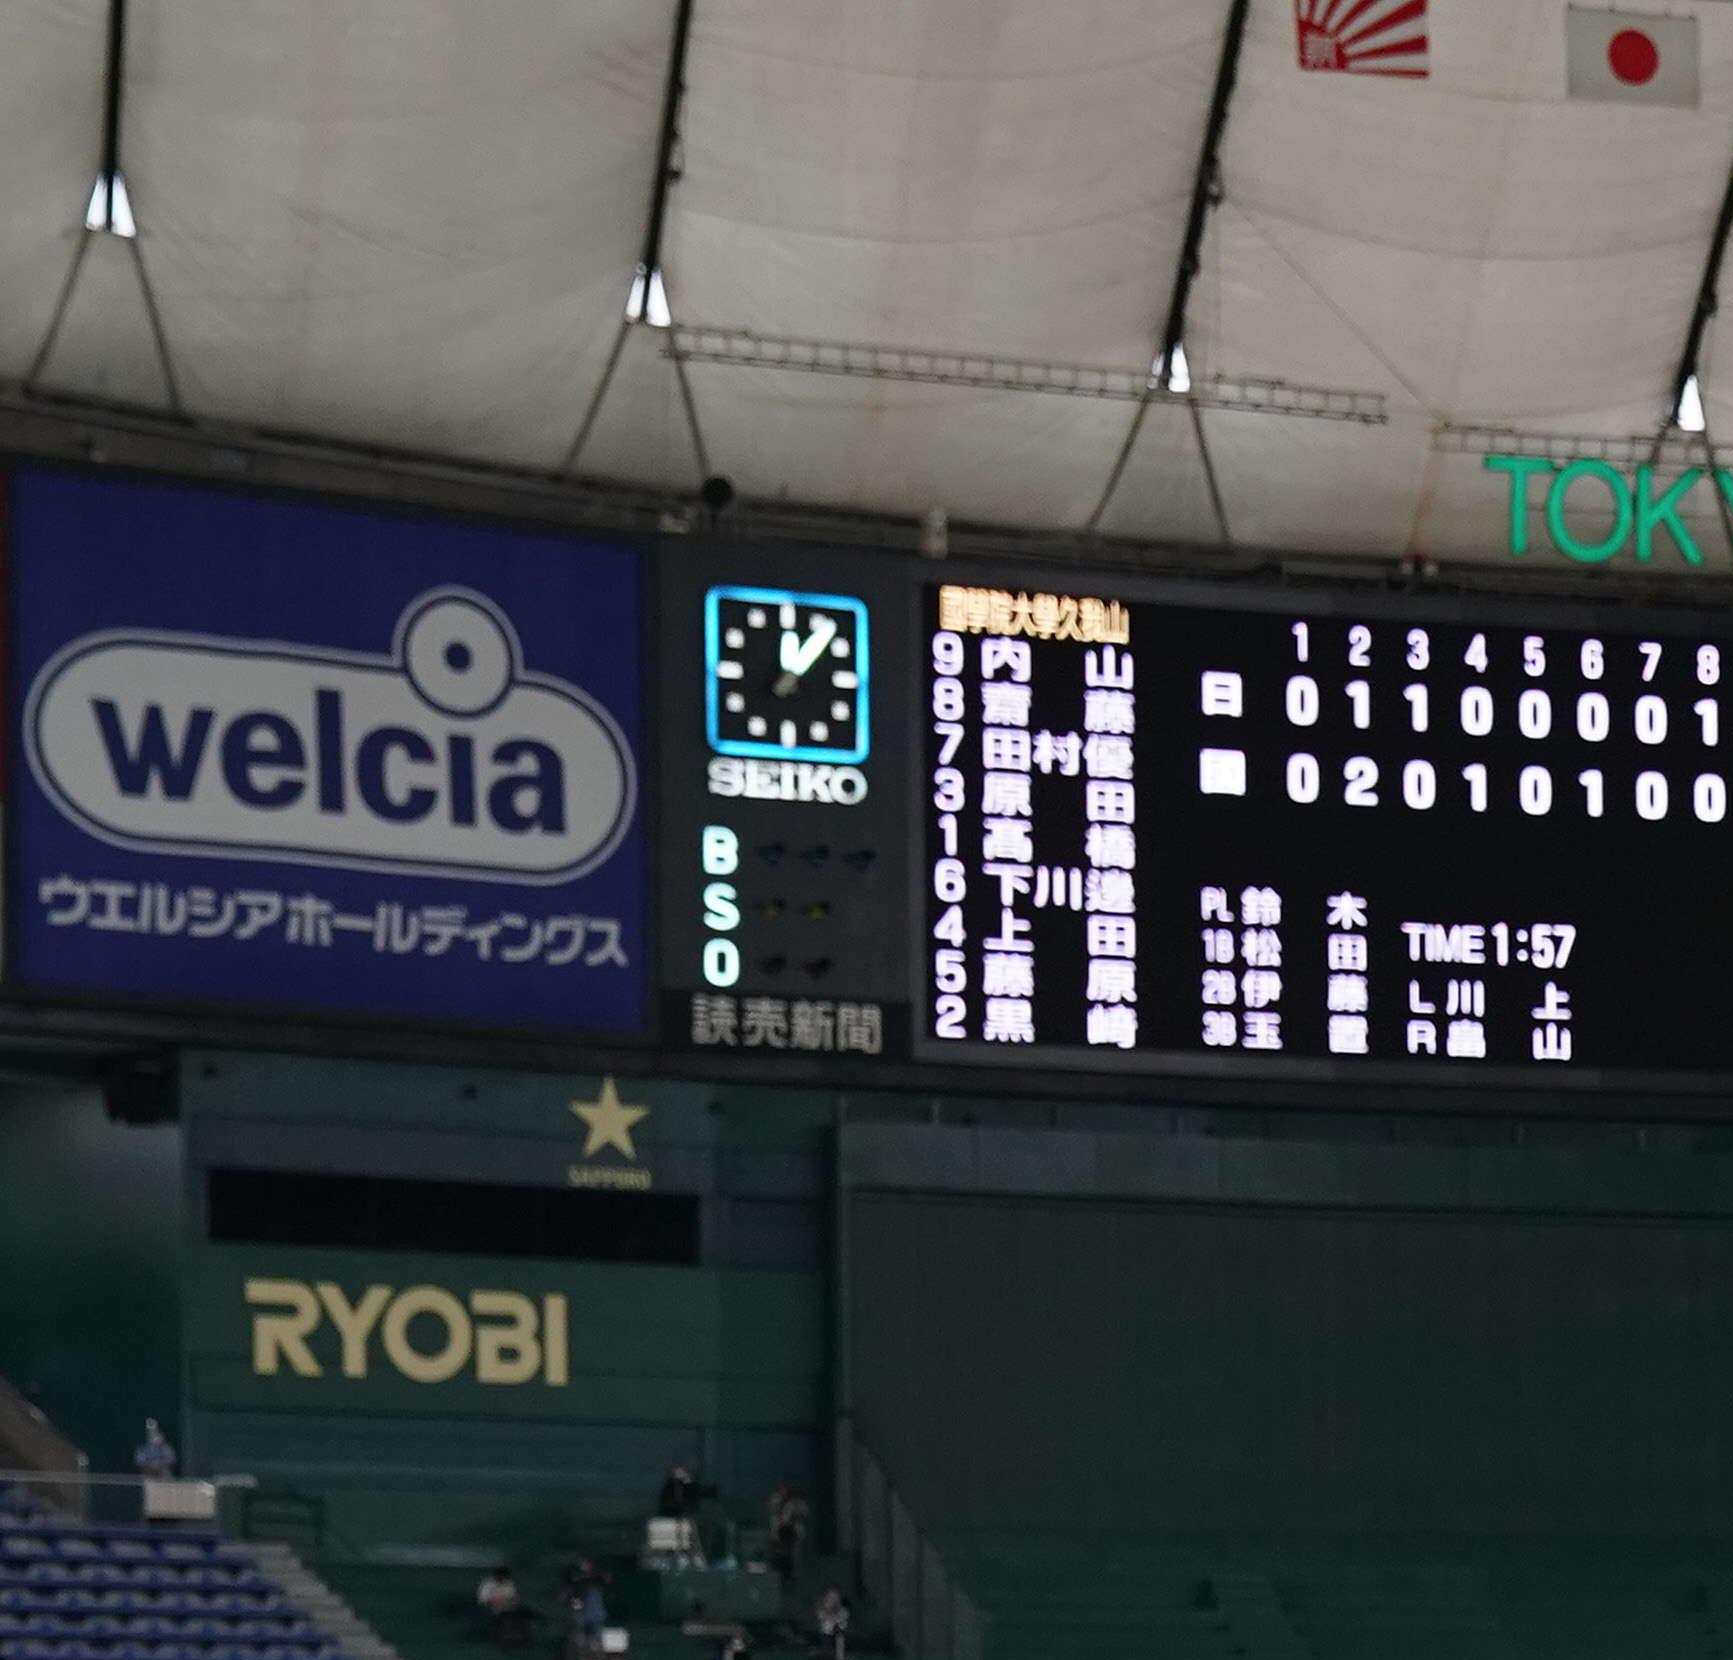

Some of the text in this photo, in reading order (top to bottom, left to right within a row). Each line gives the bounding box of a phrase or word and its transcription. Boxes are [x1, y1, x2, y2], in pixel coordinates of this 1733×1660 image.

[932, 631, 1134, 690] 9 内山
[1292, 622, 1309, 662] 1
[1348, 625, 1372, 667] 2
[1406, 629, 1430, 671] 3
[1464, 633, 1488, 673] 4
[1523, 636, 1546, 677] 5
[1580, 639, 1604, 680] 6
[1638, 642, 1662, 682] 7
[1696, 644, 1720, 686] 8
[932, 677, 965, 722] 8
[1201, 671, 1243, 718] 日
[1286, 675, 1319, 726] 0
[1345, 680, 1370, 729] 1
[1403, 684, 1428, 732] 1
[1460, 686, 1494, 736] 0
[1518, 689, 1552, 739] 0
[1576, 692, 1610, 742] 0
[1634, 695, 1668, 745] 0
[1693, 698, 1719, 747] 1
[91, 688, 568, 837] welcia
[934, 722, 965, 765] 7
[708, 757, 868, 806] SEIKO
[934, 767, 965, 812] 3
[1286, 753, 1320, 804] 0
[1343, 756, 1379, 807] 2
[1403, 759, 1436, 810] 0
[1462, 763, 1487, 812] 1
[1519, 765, 1553, 816] 0
[1578, 769, 1604, 818] 1
[1635, 771, 1669, 821] 0
[1693, 773, 1727, 823] 0
[703, 825, 740, 877] B
[938, 813, 958, 856] 1
[934, 858, 967, 903] 6
[38, 874, 629, 970] ウエルシアホールディングス
[704, 882, 740, 933] S
[933, 905, 1136, 959] 4 上田
[1402, 922, 1577, 969] TIME 1:57
[935, 949, 967, 994] 5
[691, 993, 883, 1056] 読売新聞
[935, 994, 967, 1039] 2
[1409, 979, 1572, 1020] L 川上
[1407, 1020, 1437, 1055] R
[243, 1276, 569, 1388] RYOBI
